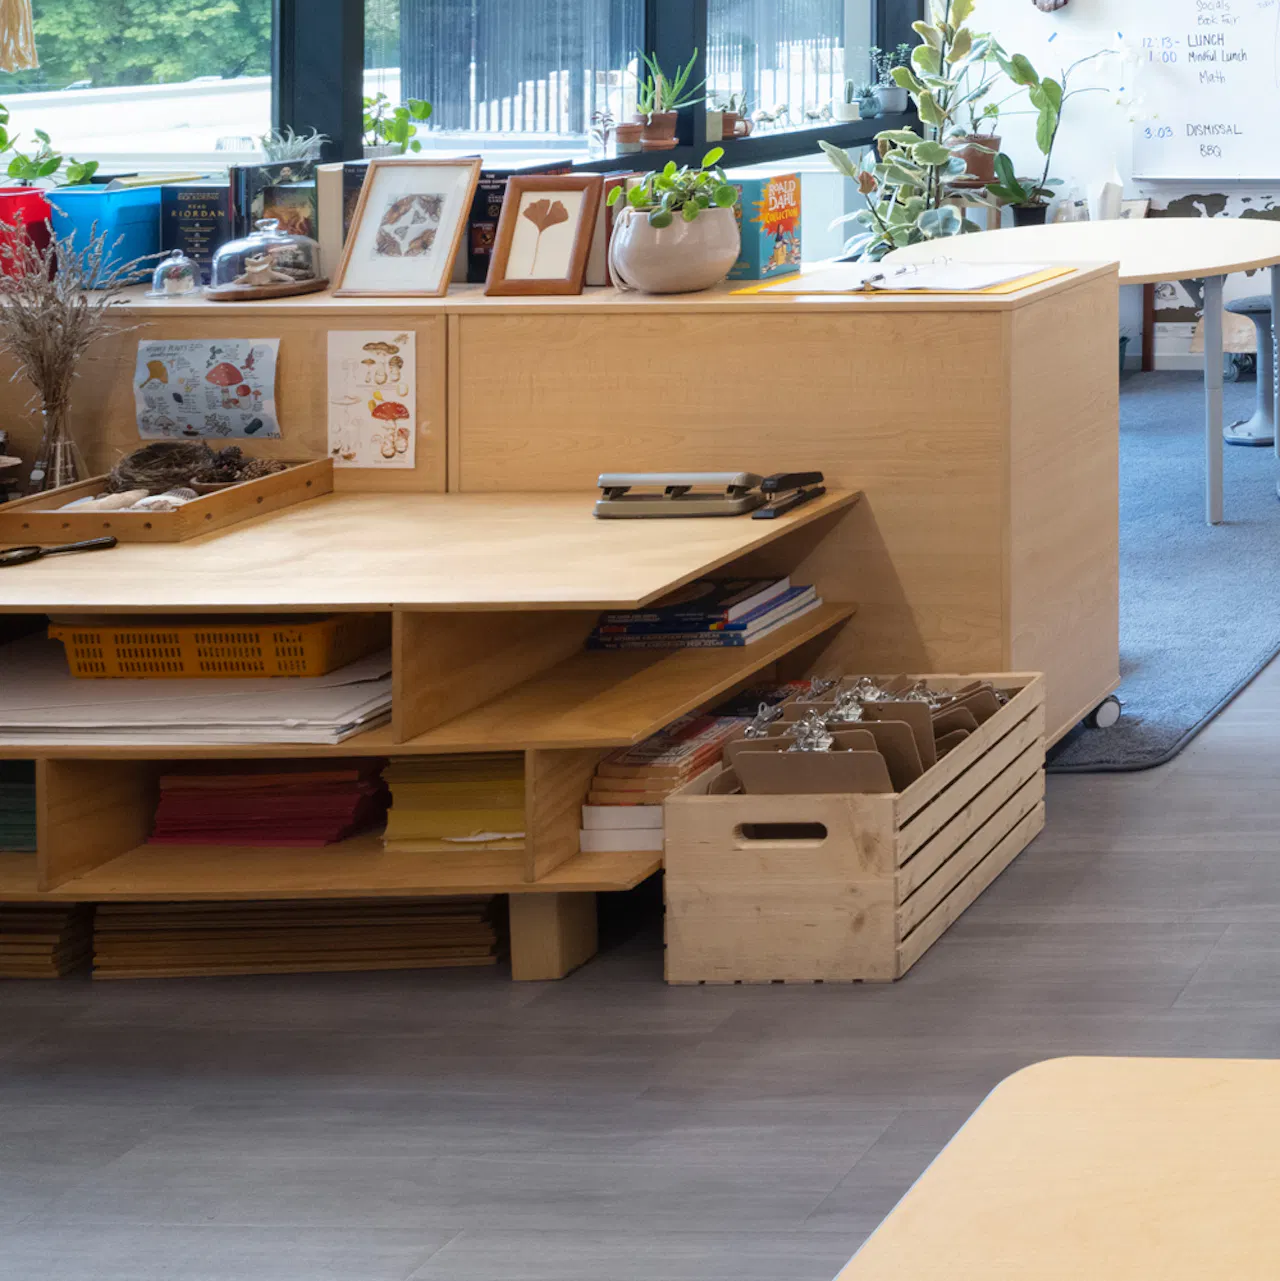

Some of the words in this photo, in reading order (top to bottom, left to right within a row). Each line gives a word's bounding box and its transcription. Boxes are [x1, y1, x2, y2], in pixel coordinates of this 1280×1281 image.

[1198, 16, 1217, 25] Book
[1221, 14, 1240, 25] Fair
[1188, 33, 1224, 47] LUNCH
[1149, 51, 1177, 62] 1:00
[1188, 50, 1216, 62] Mindful
[1222, 48, 1248, 62] Lunch
[1199, 70, 1226, 84] Math
[1144, 126, 1173, 139] 3:03
[1186, 124, 1242, 136] DISMISSAL
[1200, 144, 1222, 158] BBQ
[768, 180, 796, 197] ROALD
[768, 195, 796, 211] DAHL
[765, 207, 798, 224] COLLECTION
